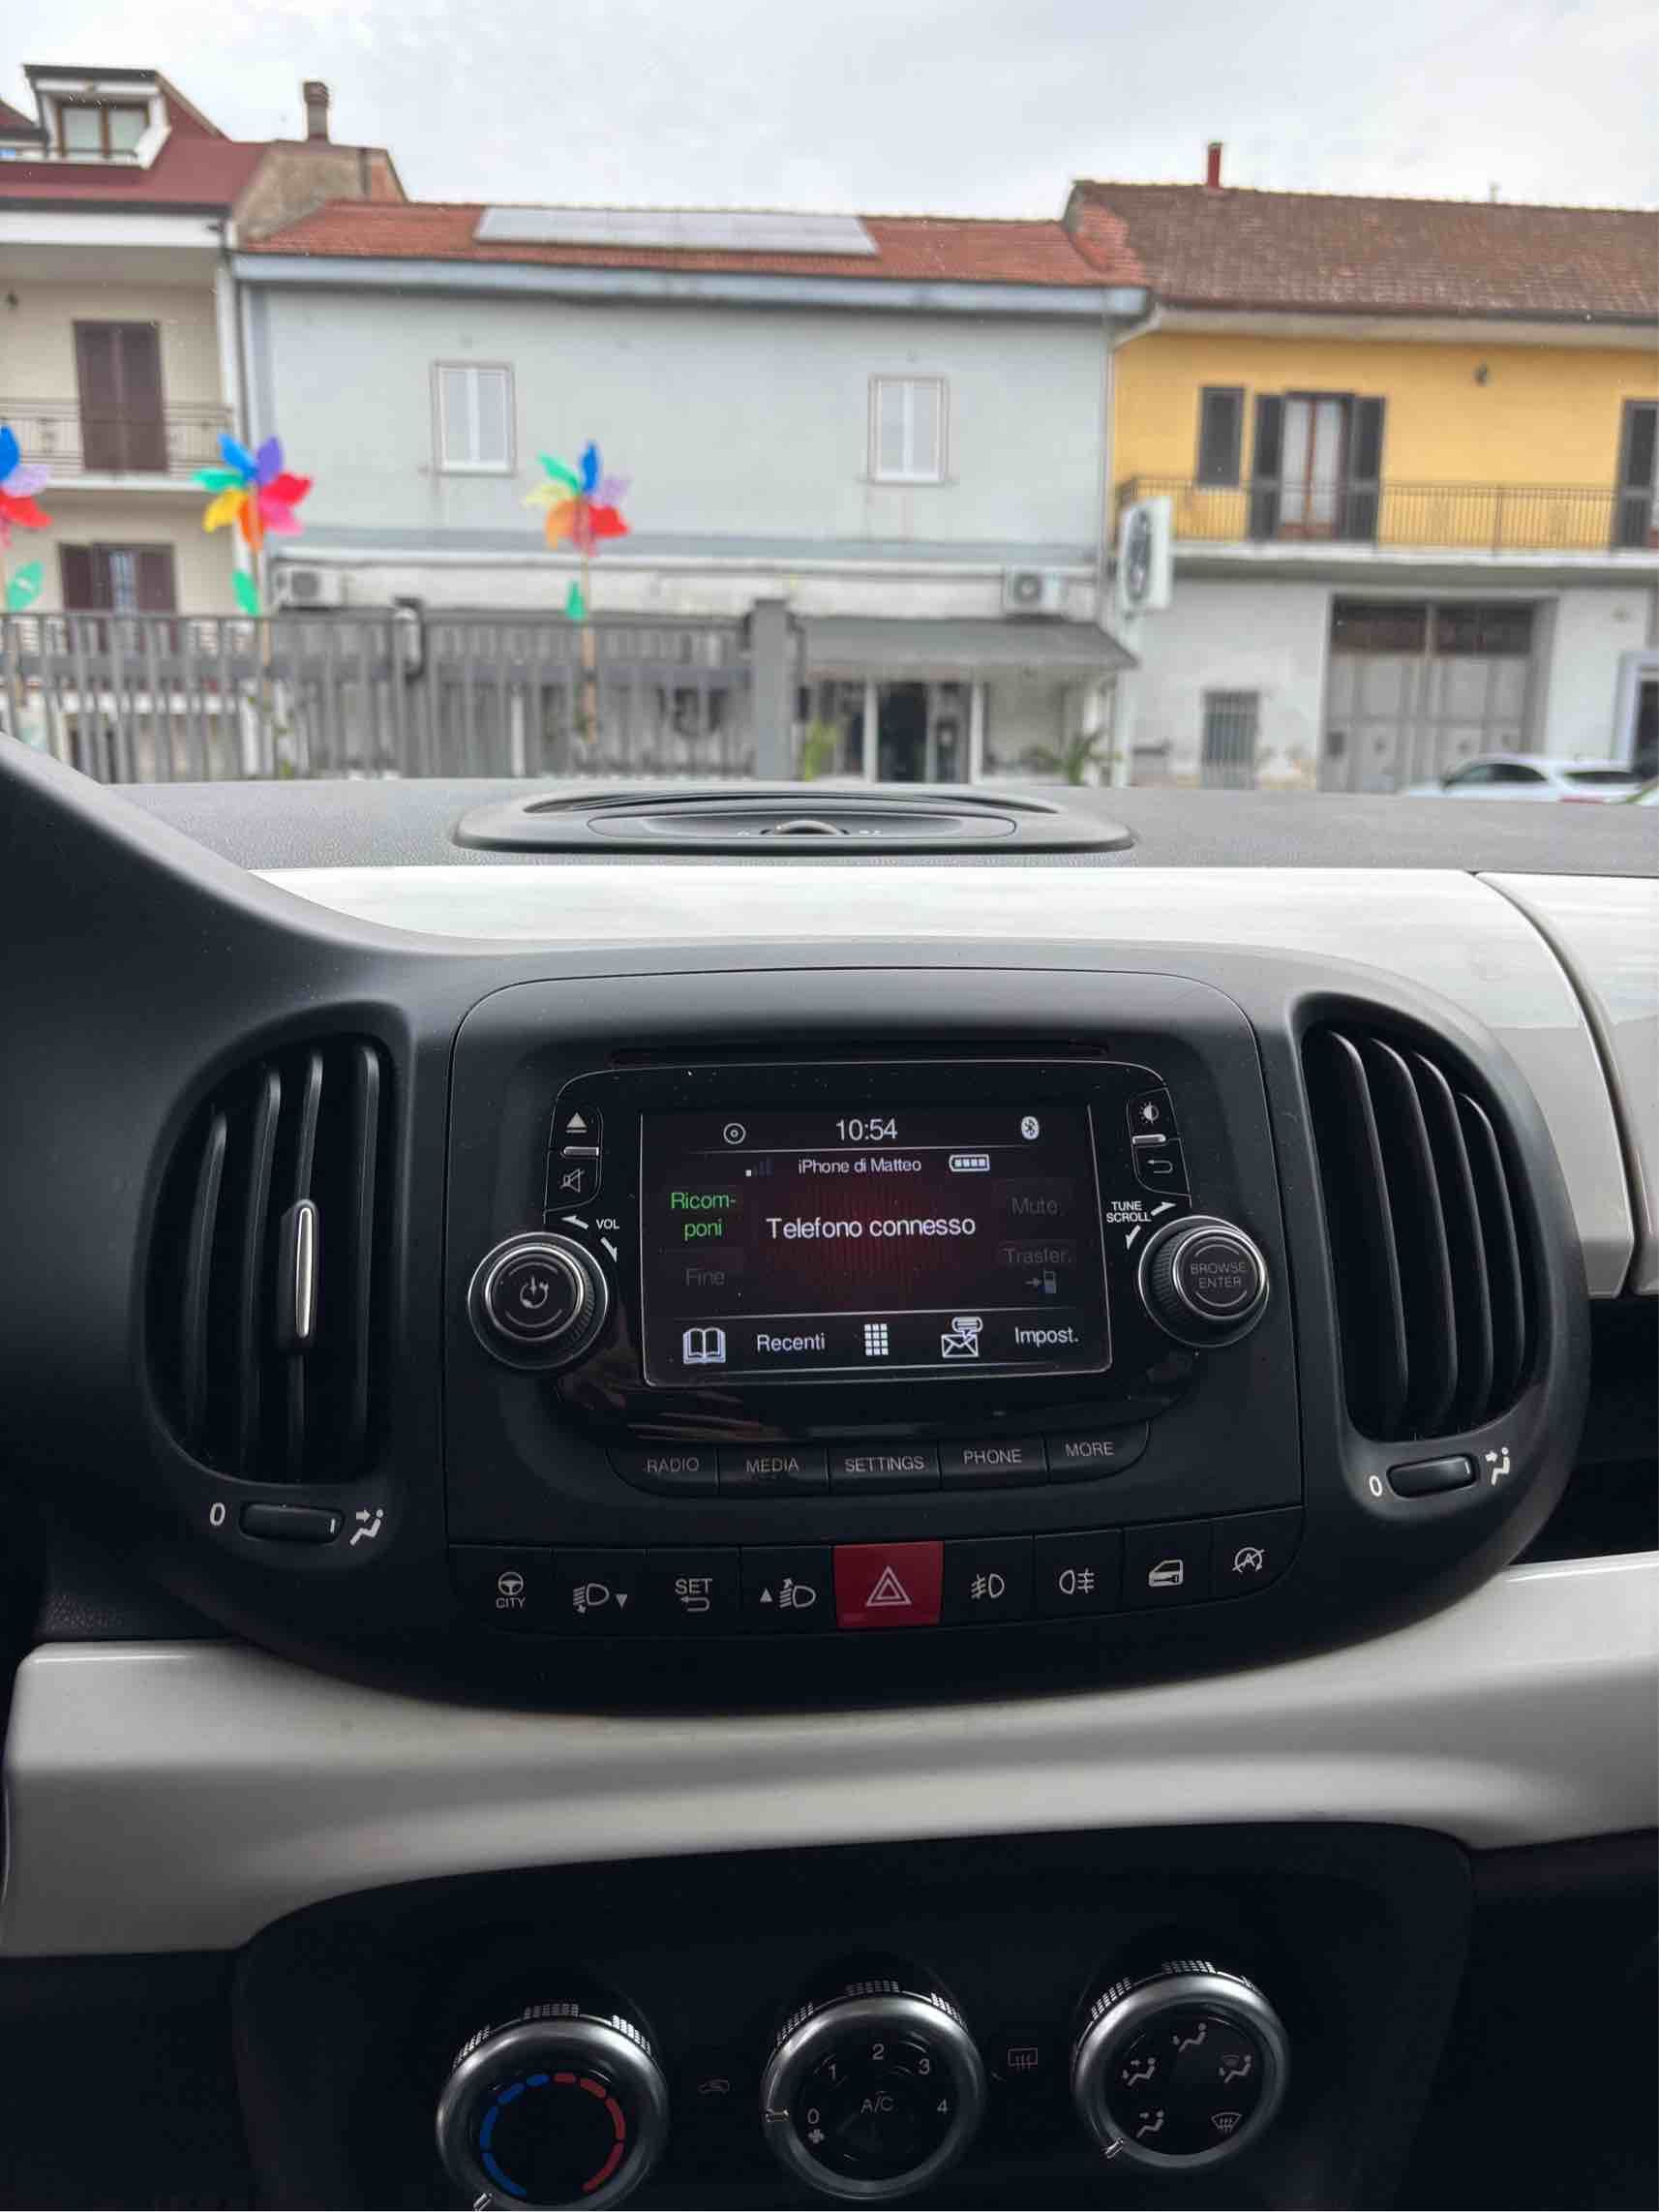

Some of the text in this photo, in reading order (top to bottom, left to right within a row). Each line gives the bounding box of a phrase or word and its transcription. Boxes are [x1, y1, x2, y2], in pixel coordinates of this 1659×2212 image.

[835, 1118, 898, 1141] 10:54
[798, 1158, 921, 1173] iPhone di Matteo
[671, 1192, 736, 1210] Ricom-
[1011, 1197, 1058, 1215] Mute
[1111, 1200, 1142, 1211] TUNE
[595, 1218, 619, 1229] VOL
[1106, 1212, 1152, 1223] SCROLL
[683, 1222, 723, 1241] poni
[767, 1215, 976, 1240] Telefono connesso
[1190, 1261, 1247, 1275] BROWSE
[685, 1267, 725, 1287] Fine
[1198, 1277, 1242, 1289] ENTER
[757, 1332, 826, 1353] Recenti
[1015, 1326, 1079, 1348] Impost.
[963, 1448, 1022, 1465] PHONE
[1065, 1440, 1114, 1458] MORE
[647, 1458, 700, 1473] RADIO
[745, 1459, 799, 1474] MEDIA
[844, 1455, 924, 1472] SETTINGS
[675, 1578, 713, 1595] SET
[496, 1596, 527, 1609] CITY
[872, 2044, 885, 2060] 2
[828, 2063, 836, 2080] 1
[919, 2059, 930, 2075] 3
[860, 2097, 893, 2113] A/C
[936, 2099, 949, 2113] 4
